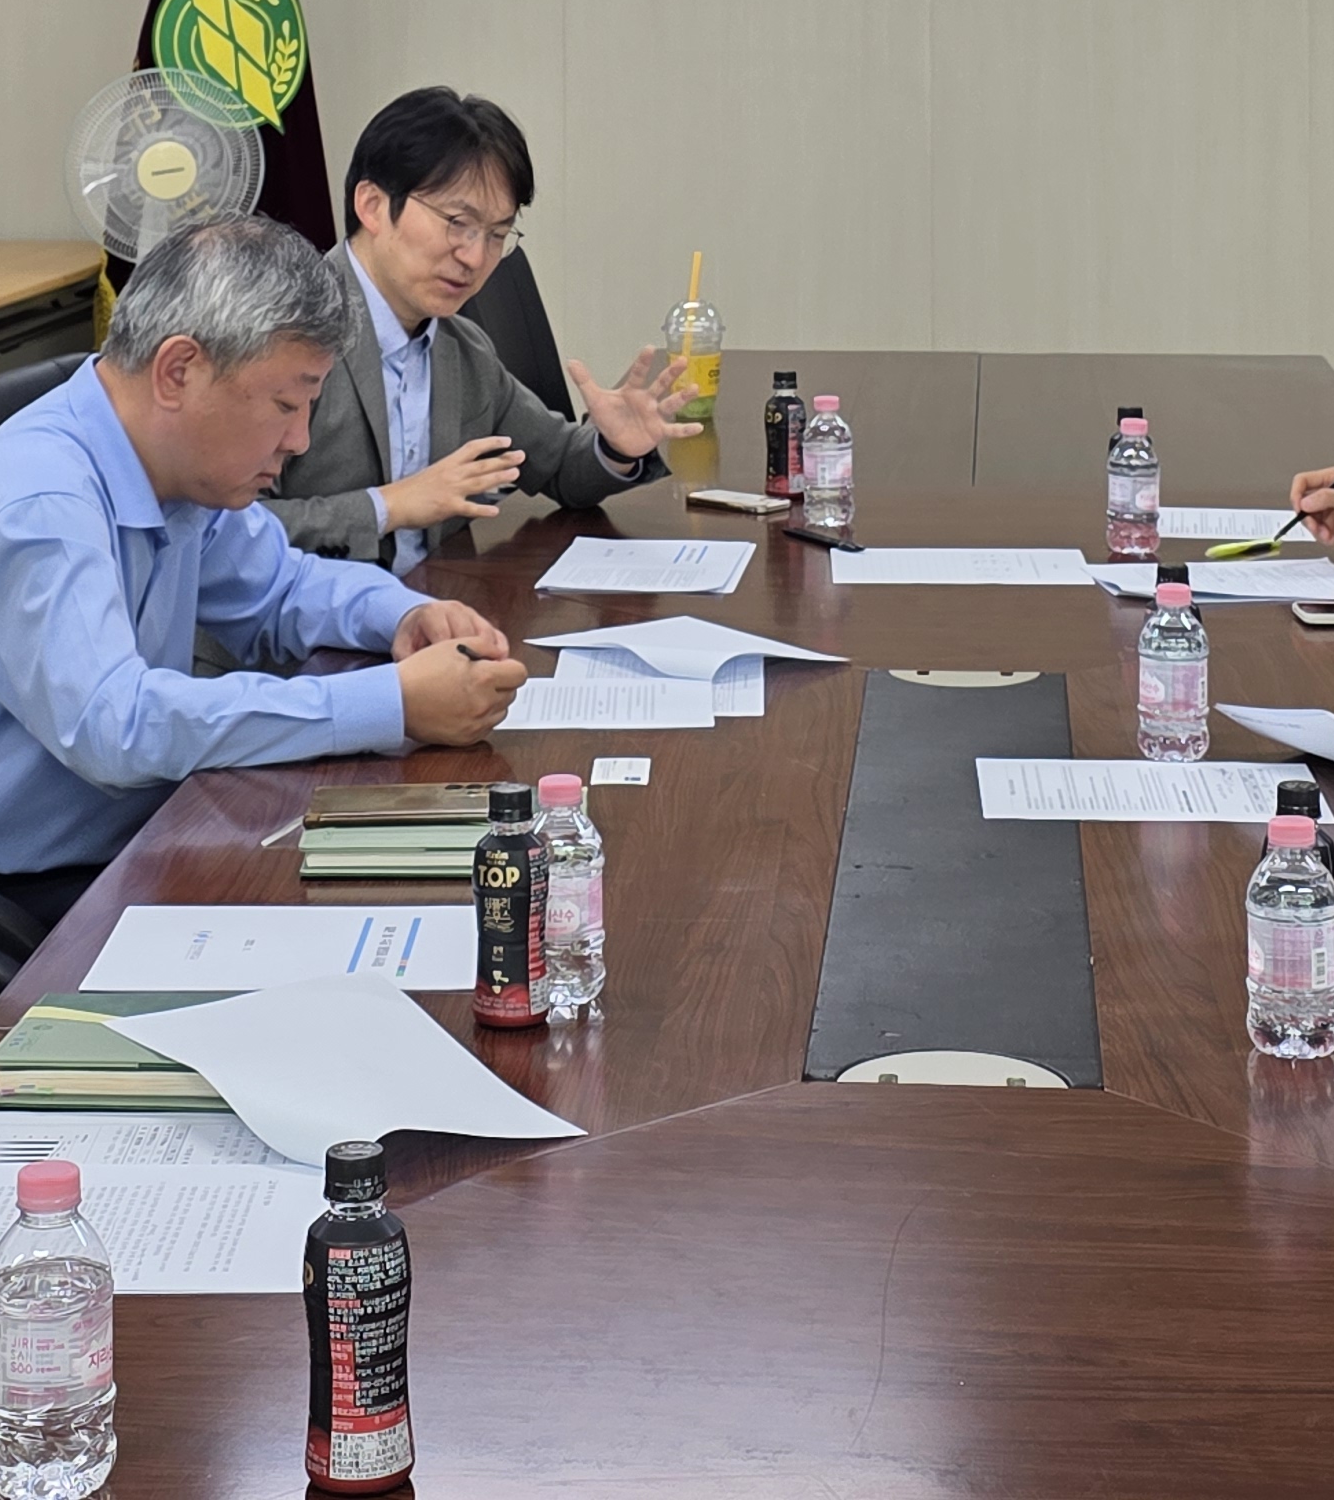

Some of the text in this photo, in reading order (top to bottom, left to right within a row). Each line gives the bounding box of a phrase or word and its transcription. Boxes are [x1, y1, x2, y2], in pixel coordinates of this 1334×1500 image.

[478, 865, 520, 888] T.O.P
[11, 1337, 33, 1350] JIRI
[10, 1361, 33, 1374] SOO
